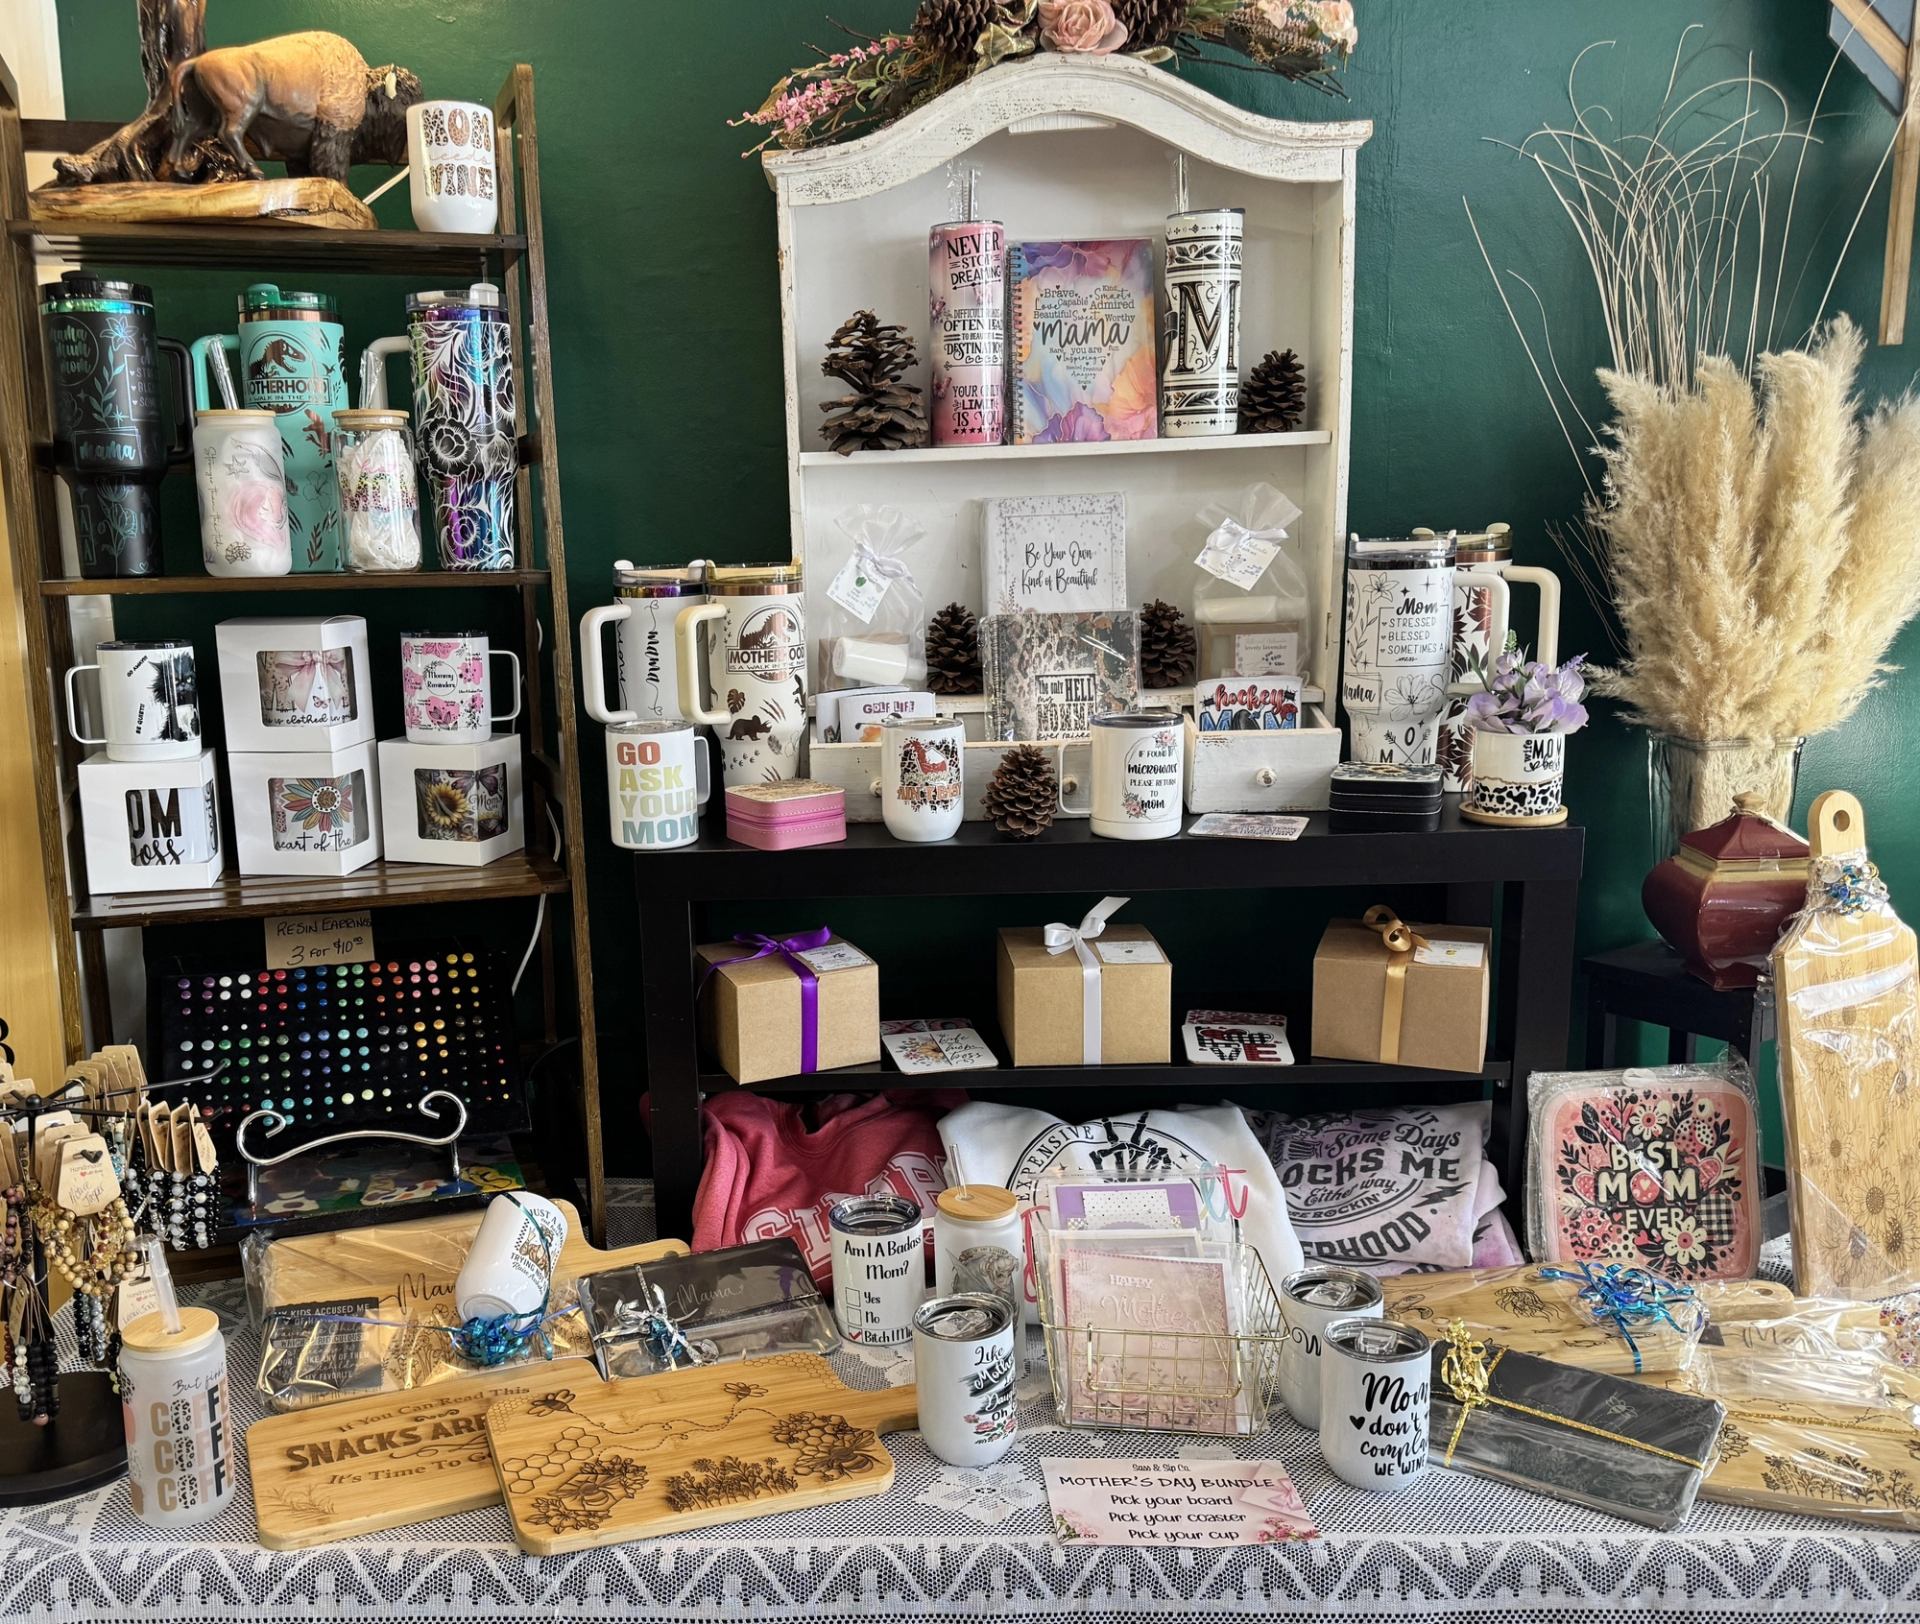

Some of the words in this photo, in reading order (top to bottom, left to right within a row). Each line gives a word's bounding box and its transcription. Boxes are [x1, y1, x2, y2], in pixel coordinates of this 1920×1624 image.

[421, 110, 491, 152] MOM
[946, 231, 1000, 258] NEVER
[1044, 288, 1075, 298] Brave
[1058, 299, 1089, 307] Capable
[1090, 300, 1135, 310] Admired
[1034, 310, 1071, 319] Beautiful
[1105, 313, 1136, 323] Worthy
[944, 319, 984, 332] OFTEN
[1071, 346, 1087, 356] you
[1088, 345, 1102, 353] are
[953, 385, 978, 398] YOUR
[1025, 542, 1040, 568] Be
[1043, 541, 1066, 568] Your
[1069, 540, 1093, 567] Own
[1022, 568, 1043, 595] Kind
[1045, 575, 1053, 592] of
[1055, 567, 1098, 594] Beautiful
[1396, 598, 1439, 616] Mom
[1388, 617, 1437, 629] STRESSED
[1388, 630, 1431, 642] BLESSED
[1387, 643, 1437, 655] SOMETIMES
[1065, 678, 1094, 702] HELL
[1215, 683, 1286, 715] hockey
[862, 701, 890, 714] GOLF
[616, 741, 661, 766] GO
[1523, 739, 1533, 764] wife
[619, 765, 685, 792] ASK
[1130, 779, 1153, 787] PLEASE
[619, 788, 697, 818] YOUR
[622, 814, 699, 845] MOM
[313, 833, 331, 852] of
[277, 920, 318, 936] RESIN
[286, 945, 305, 966] 3
[1325, 1130, 1391, 1159] Some
[1394, 1123, 1462, 1156] Days
[1016, 1125, 1094, 1202] EXPENSIVE
[1612, 1140, 1680, 1172] BEST
[1400, 1150, 1461, 1182] ME
[1598, 1167, 1698, 1204] MOM
[1303, 1184, 1359, 1207] Either
[1624, 1207, 1685, 1230] EVER
[845, 1239, 865, 1257] Am
[867, 1242, 871, 1258] I
[875, 1241, 885, 1258] A
[510, 1252, 536, 1273] TRYING
[866, 1260, 909, 1280] Mom?
[1109, 1273, 1155, 1290] HAPPY
[864, 1291, 881, 1304] Yes
[315, 1305, 354, 1316] ACCUSED
[356, 1303, 370, 1313] ME
[865, 1311, 880, 1324] No
[864, 1331, 890, 1343] Bitch
[172, 1379, 202, 1397] But
[338, 1423, 353, 1433] If
[355, 1412, 393, 1425] You
[397, 1402, 434, 1415] Can
[439, 1391, 484, 1406] Read
[489, 1386, 530, 1397] This
[1369, 1411, 1420, 1437] don't
[286, 1426, 422, 1472] SNACKS
[329, 1474, 362, 1485] It's
[367, 1464, 427, 1481] Time
[431, 1458, 461, 1471] To
[1163, 1464, 1176, 1473] Sip
[1374, 1461, 1395, 1476] WE
[1059, 1476, 1154, 1488] MOTHER'S
[1158, 1478, 1196, 1492] DAY
[1202, 1478, 1274, 1489] BUNDLE
[1110, 1494, 1140, 1505] Pick
[1144, 1496, 1183, 1509] your
[1187, 1495, 1233, 1506] board
[1108, 1511, 1139, 1522] Pick
[1143, 1513, 1182, 1525] your
[1186, 1512, 1247, 1523] coaster
[1128, 1529, 1160, 1540] Pick
[1162, 1531, 1204, 1543] your
[1208, 1530, 1240, 1541] cup
